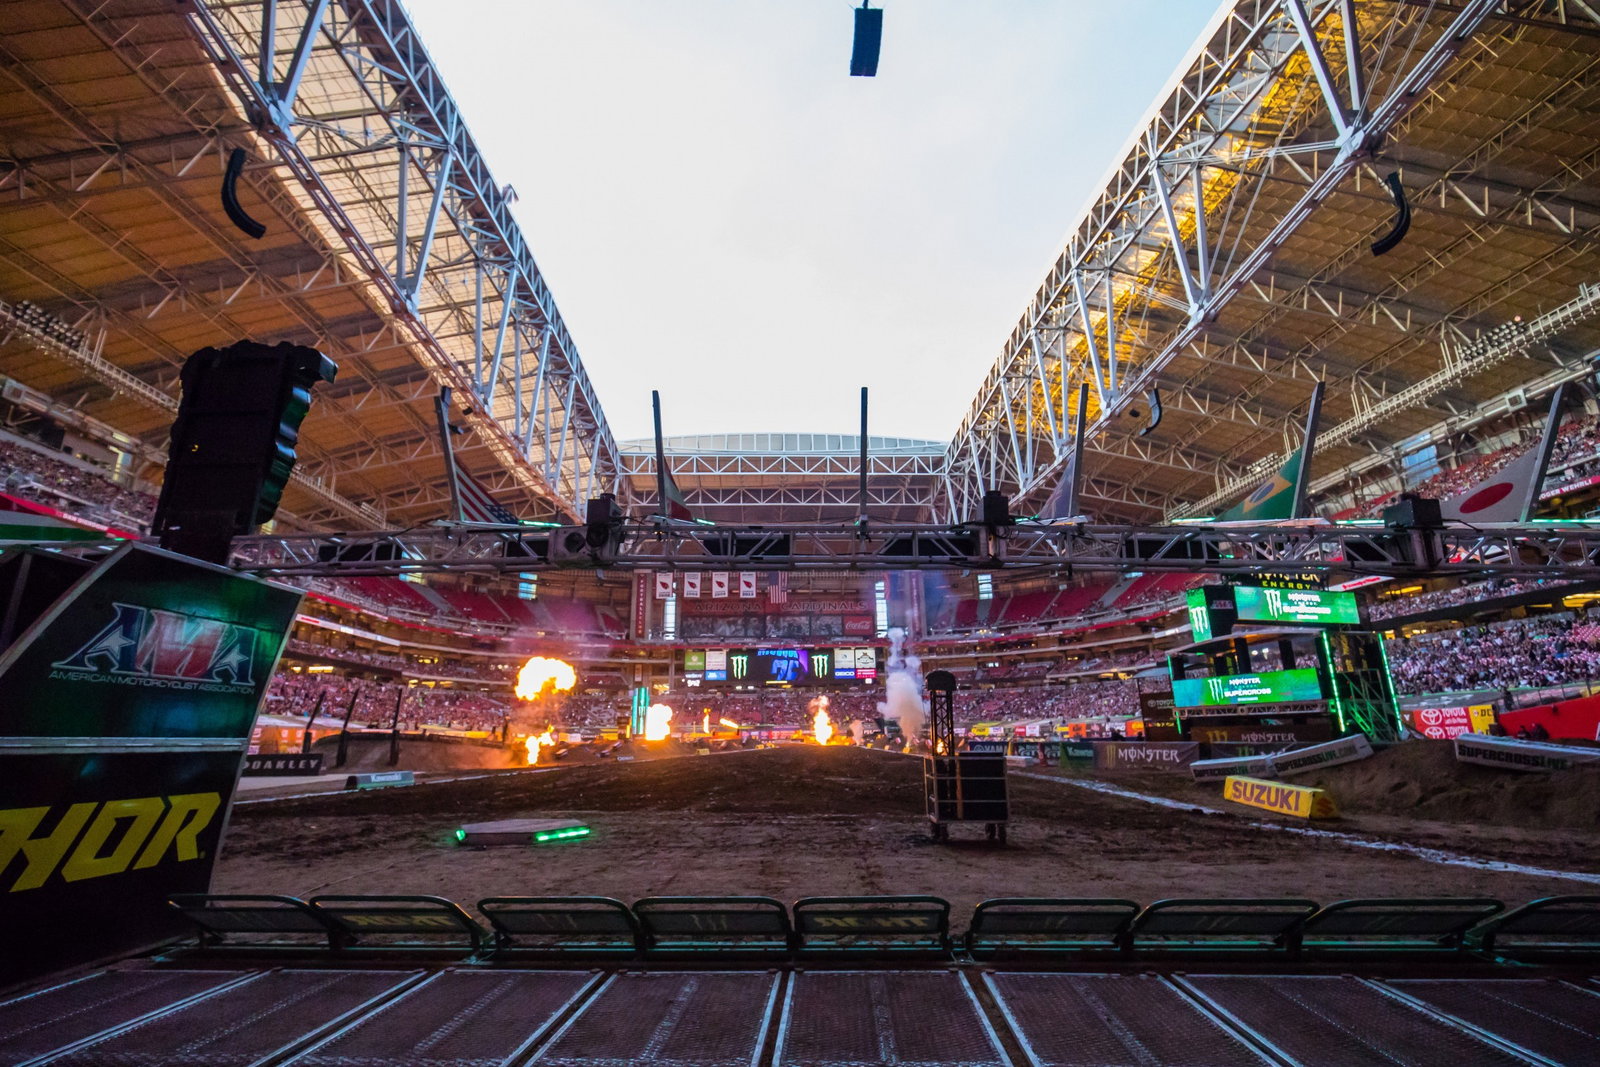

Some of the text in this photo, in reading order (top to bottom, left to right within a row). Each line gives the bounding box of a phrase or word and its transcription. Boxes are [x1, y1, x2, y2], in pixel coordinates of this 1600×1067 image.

[1561, 478, 1592, 493] WEHRLI
[1261, 580, 1312, 590] ENERGY
[695, 600, 868, 612] ARIZONA CARDINALS
[51, 602, 256, 686] AMA
[48, 670, 256, 696] AMERICAN MOTORCYCLIST ASSOCIATION
[1441, 707, 1467, 717] TOYOTA
[1241, 732, 1296, 743] MONSTER
[1118, 746, 1180, 763] MONSTER
[252, 759, 319, 770] OAKLEY
[1232, 780, 1300, 812] SUZUKI
